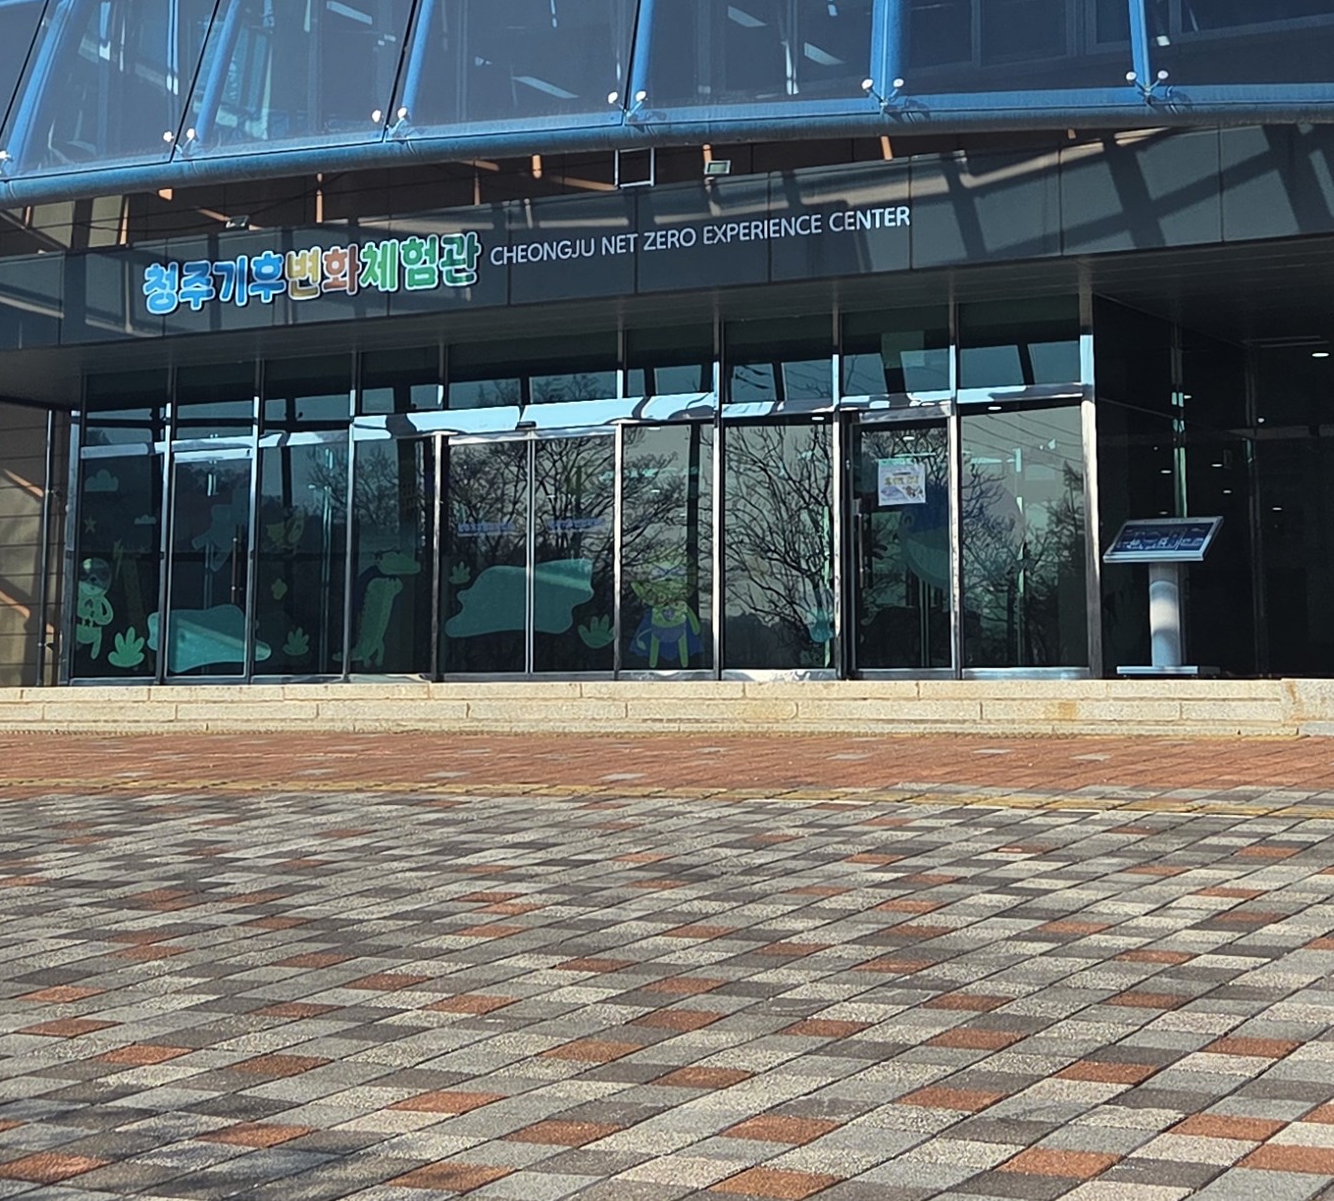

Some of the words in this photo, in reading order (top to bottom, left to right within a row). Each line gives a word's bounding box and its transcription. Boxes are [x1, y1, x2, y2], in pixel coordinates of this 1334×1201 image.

[490, 237, 595, 265] CHEONGJU
[601, 233, 638, 256] NET
[643, 227, 696, 251] ZERO
[703, 214, 822, 245] EXPERIENCE
[829, 206, 910, 232] CENTER
[143, 231, 481, 315] 청주기후변화체험관
